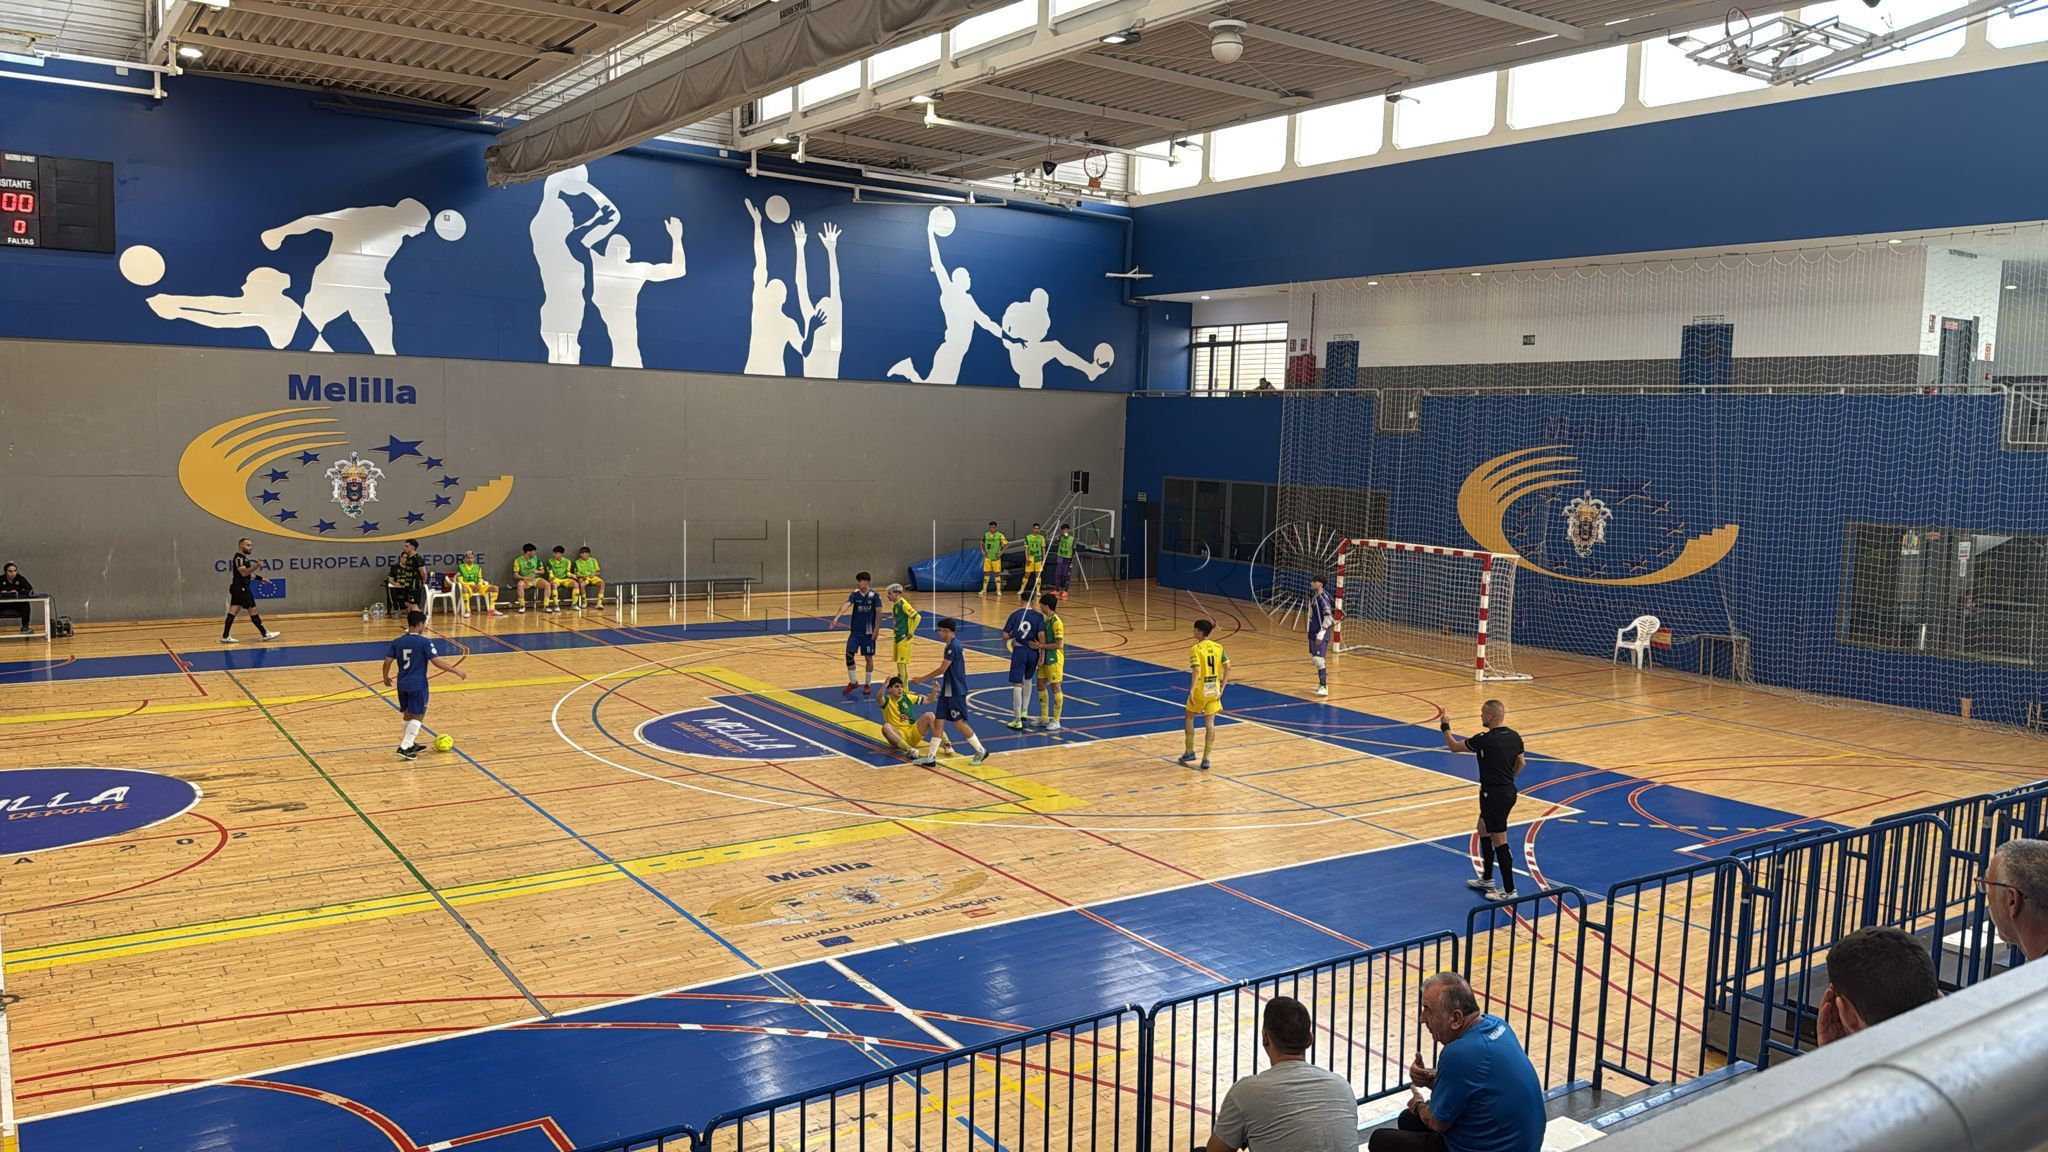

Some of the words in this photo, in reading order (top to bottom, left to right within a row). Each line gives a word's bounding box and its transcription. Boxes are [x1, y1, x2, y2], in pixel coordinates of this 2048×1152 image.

[13, 219, 27, 234] 0
[7, 237, 35, 246] FALTAS
[288, 374, 417, 404] Melilla
[290, 556, 371, 570] EUROPEA
[1020, 620, 1032, 640] 9
[402, 648, 413, 670] 5
[1207, 655, 1215, 675] 4
[7, 802, 131, 821] DEPORTE
[764, 862, 873, 883] Melilla
[781, 927, 841, 942] CIUDAD
[842, 914, 913, 931] EUROPEA
[913, 908, 942, 917] DEL
[942, 895, 1007, 911] DEPORTE
